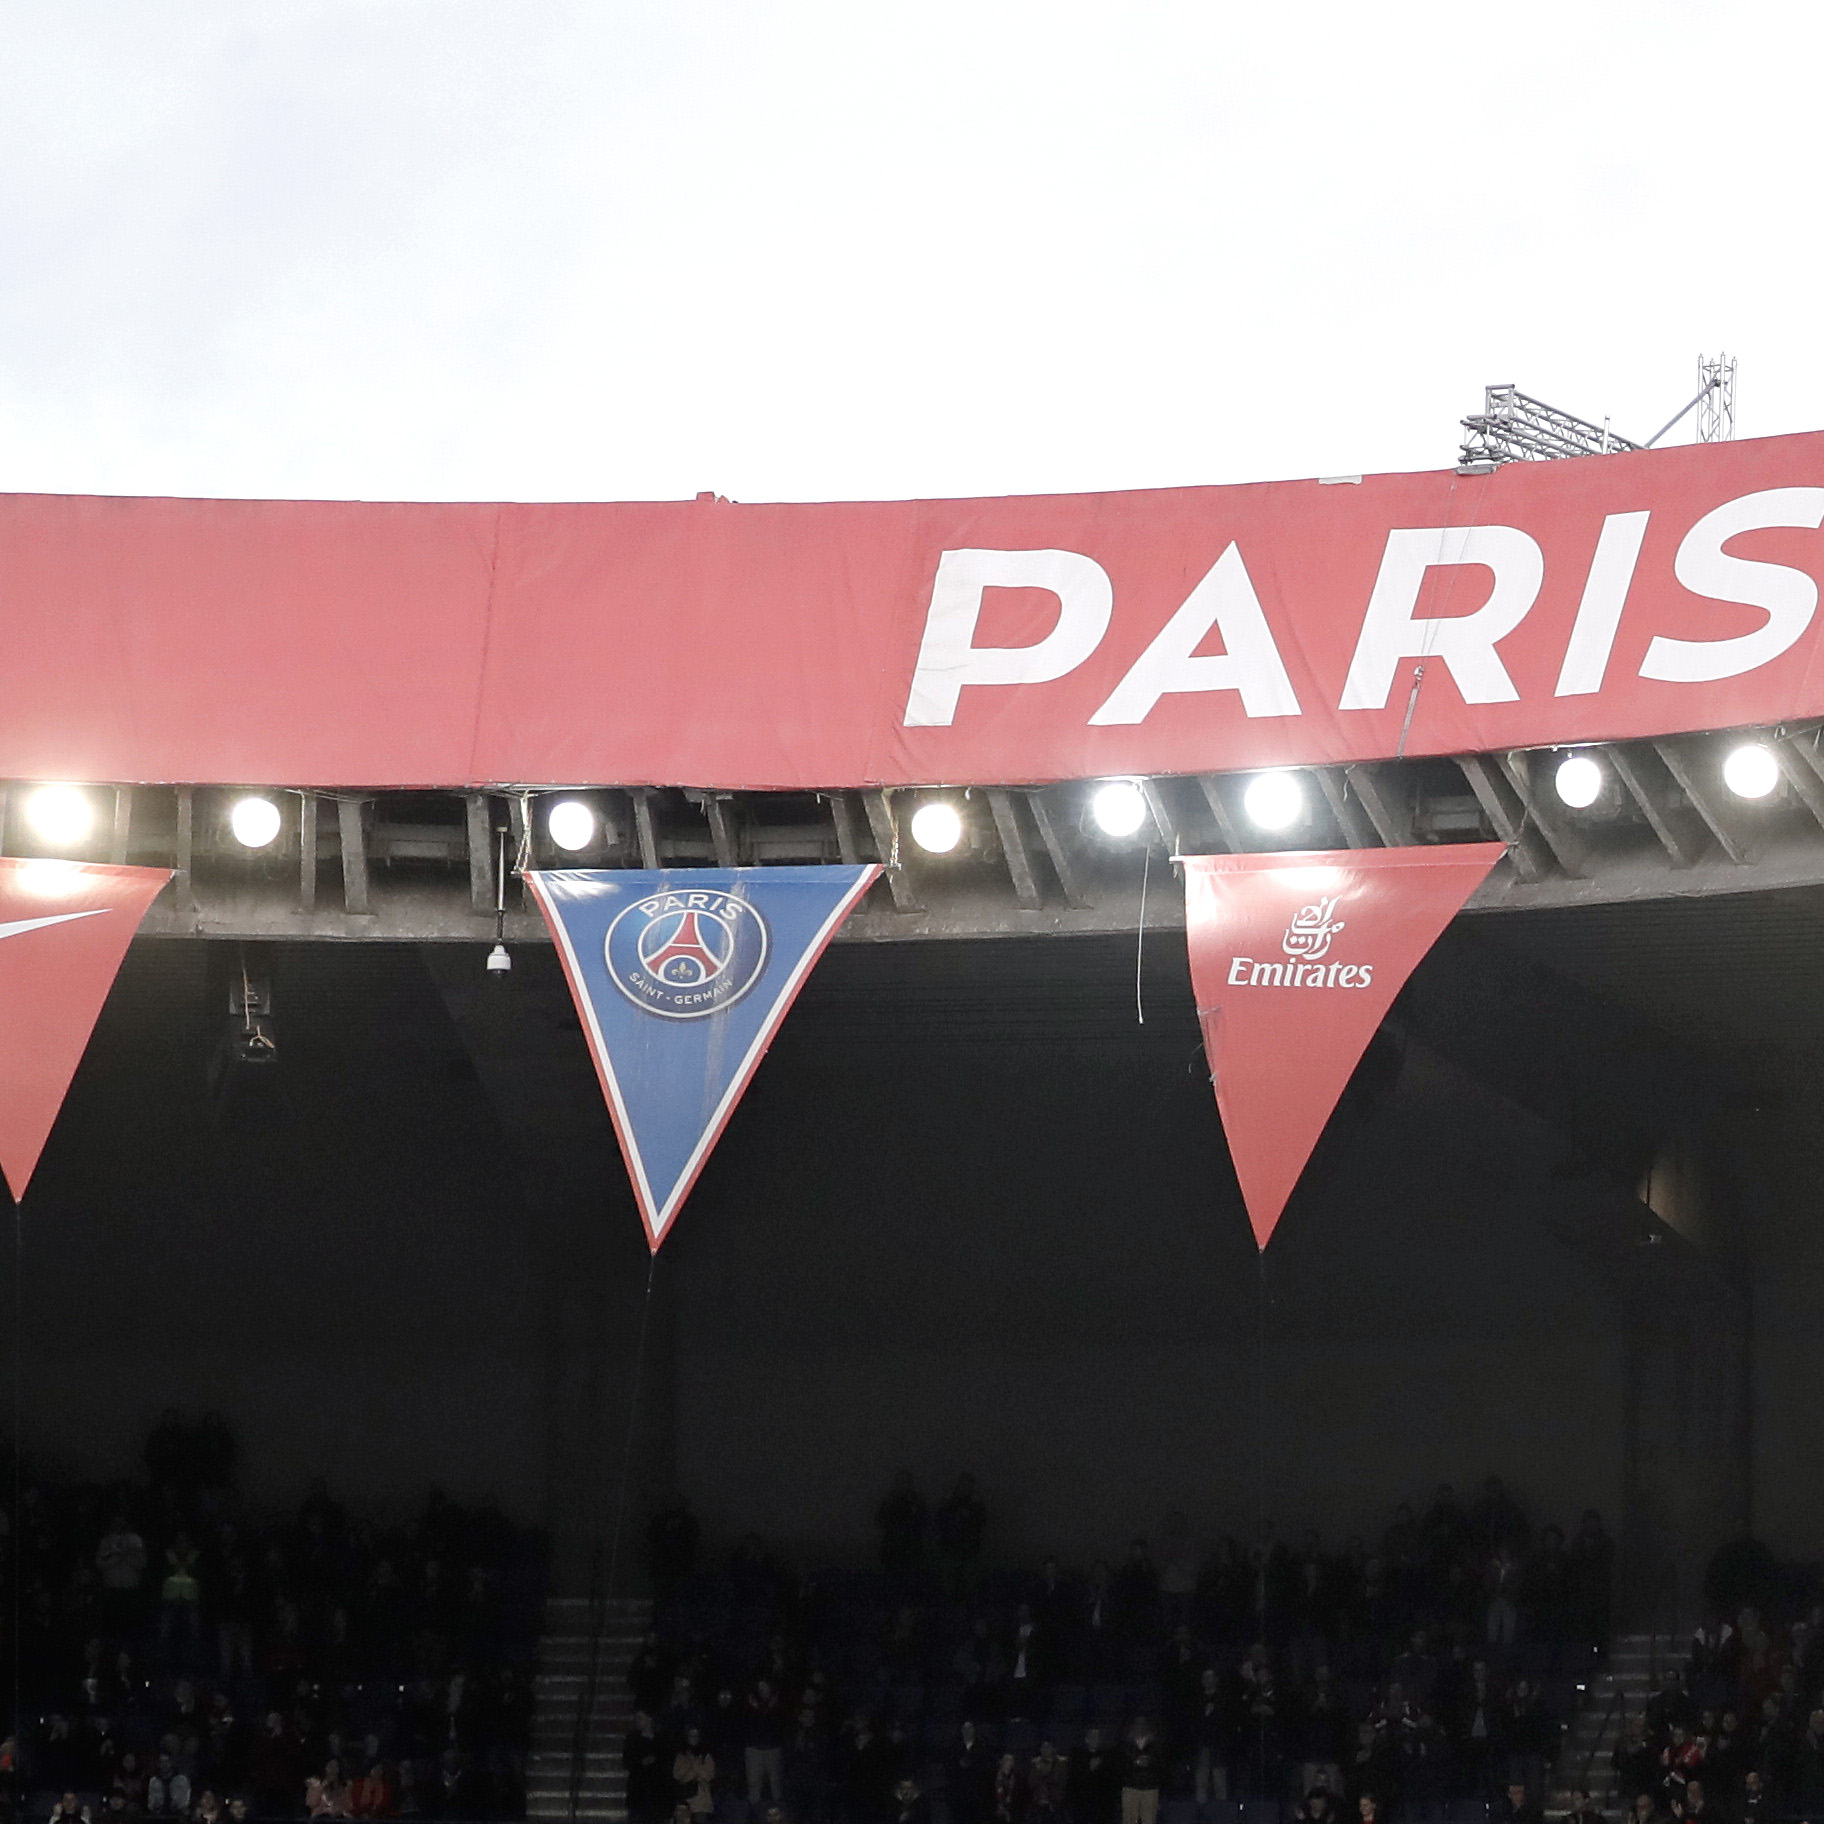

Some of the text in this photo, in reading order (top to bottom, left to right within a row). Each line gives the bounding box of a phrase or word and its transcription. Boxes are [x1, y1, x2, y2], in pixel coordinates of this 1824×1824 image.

[638, 893, 743, 921] PARIS
[1227, 957, 1374, 989] Emirates
[674, 978, 734, 1005] GERMAIN
